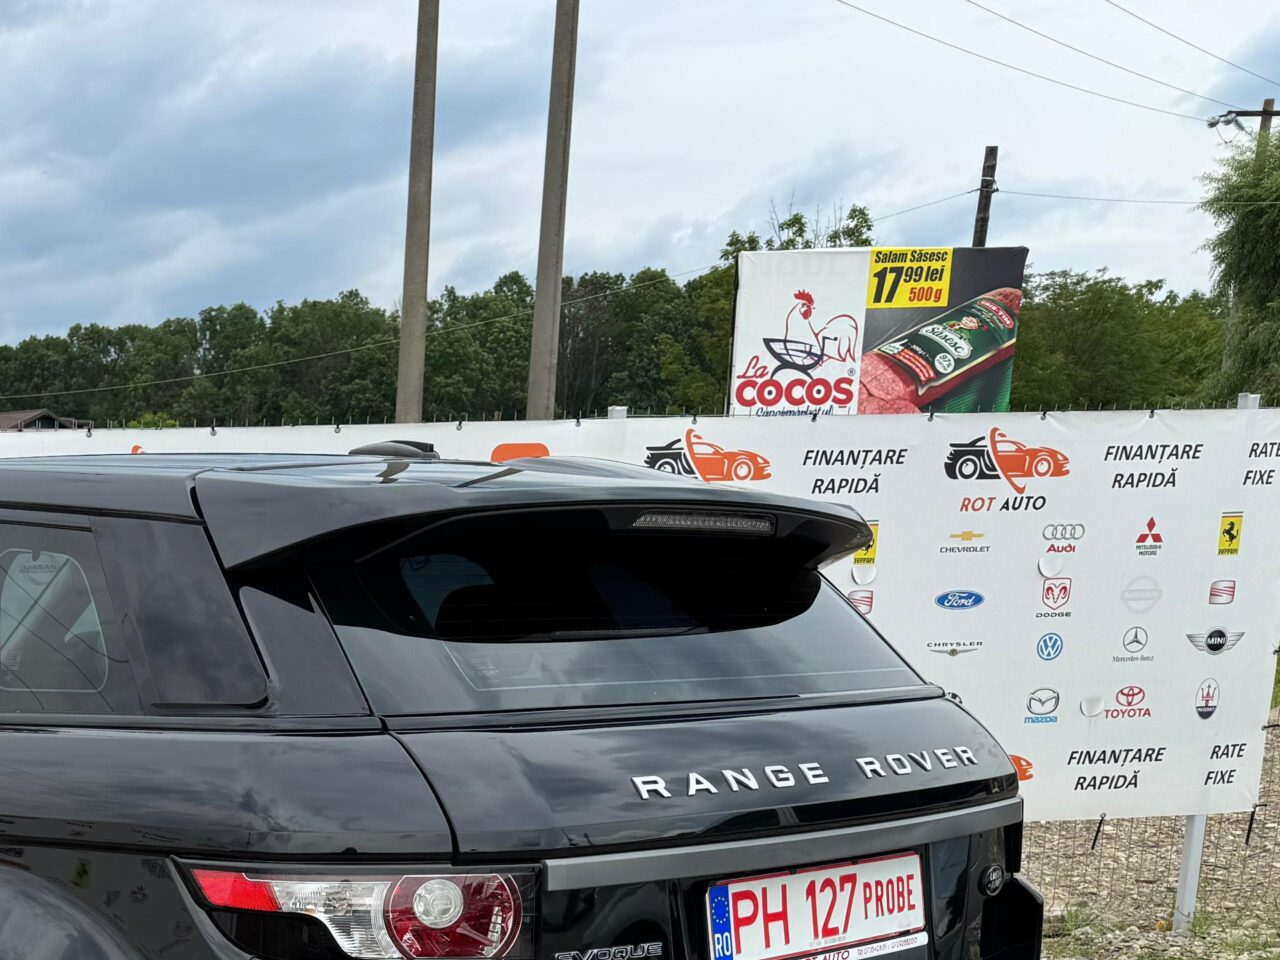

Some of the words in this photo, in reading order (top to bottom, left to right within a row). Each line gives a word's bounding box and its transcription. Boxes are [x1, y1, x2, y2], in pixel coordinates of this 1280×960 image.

[874, 251, 908, 263] Salam
[909, 249, 948, 263] Săsesc
[873, 266, 905, 303] 17
[903, 265, 924, 283] 99
[924, 264, 945, 282] lei
[908, 286, 933, 302] 500
[933, 288, 943, 303] g
[736, 355, 769, 379] La
[802, 448, 908, 470] FINANȚARE
[1104, 443, 1204, 465] FINANȚARE
[811, 473, 880, 494] RAPIDĂ
[1111, 467, 1179, 489] RAPIDĂ
[1243, 469, 1275, 486] FIXE
[959, 496, 997, 512] ROT
[999, 495, 1047, 511] AUTO
[1046, 543, 1076, 553] Audi
[944, 593, 975, 607] Ford
[1207, 637, 1226, 645] MINI
[1024, 716, 1058, 724] mazda
[1104, 708, 1152, 718] TOYOTA
[1067, 747, 1167, 769] FINANȚARE
[1210, 743, 1247, 760] RATE
[631, 762, 829, 800] RANGE
[855, 745, 979, 779] ROVER
[1074, 769, 1139, 791] RAPIDĂ
[1204, 769, 1237, 785] FIXE
[731, 883, 790, 954] PH
[805, 872, 858, 943] 127
[863, 873, 916, 920] PROBE
[713, 930, 732, 958] RO
